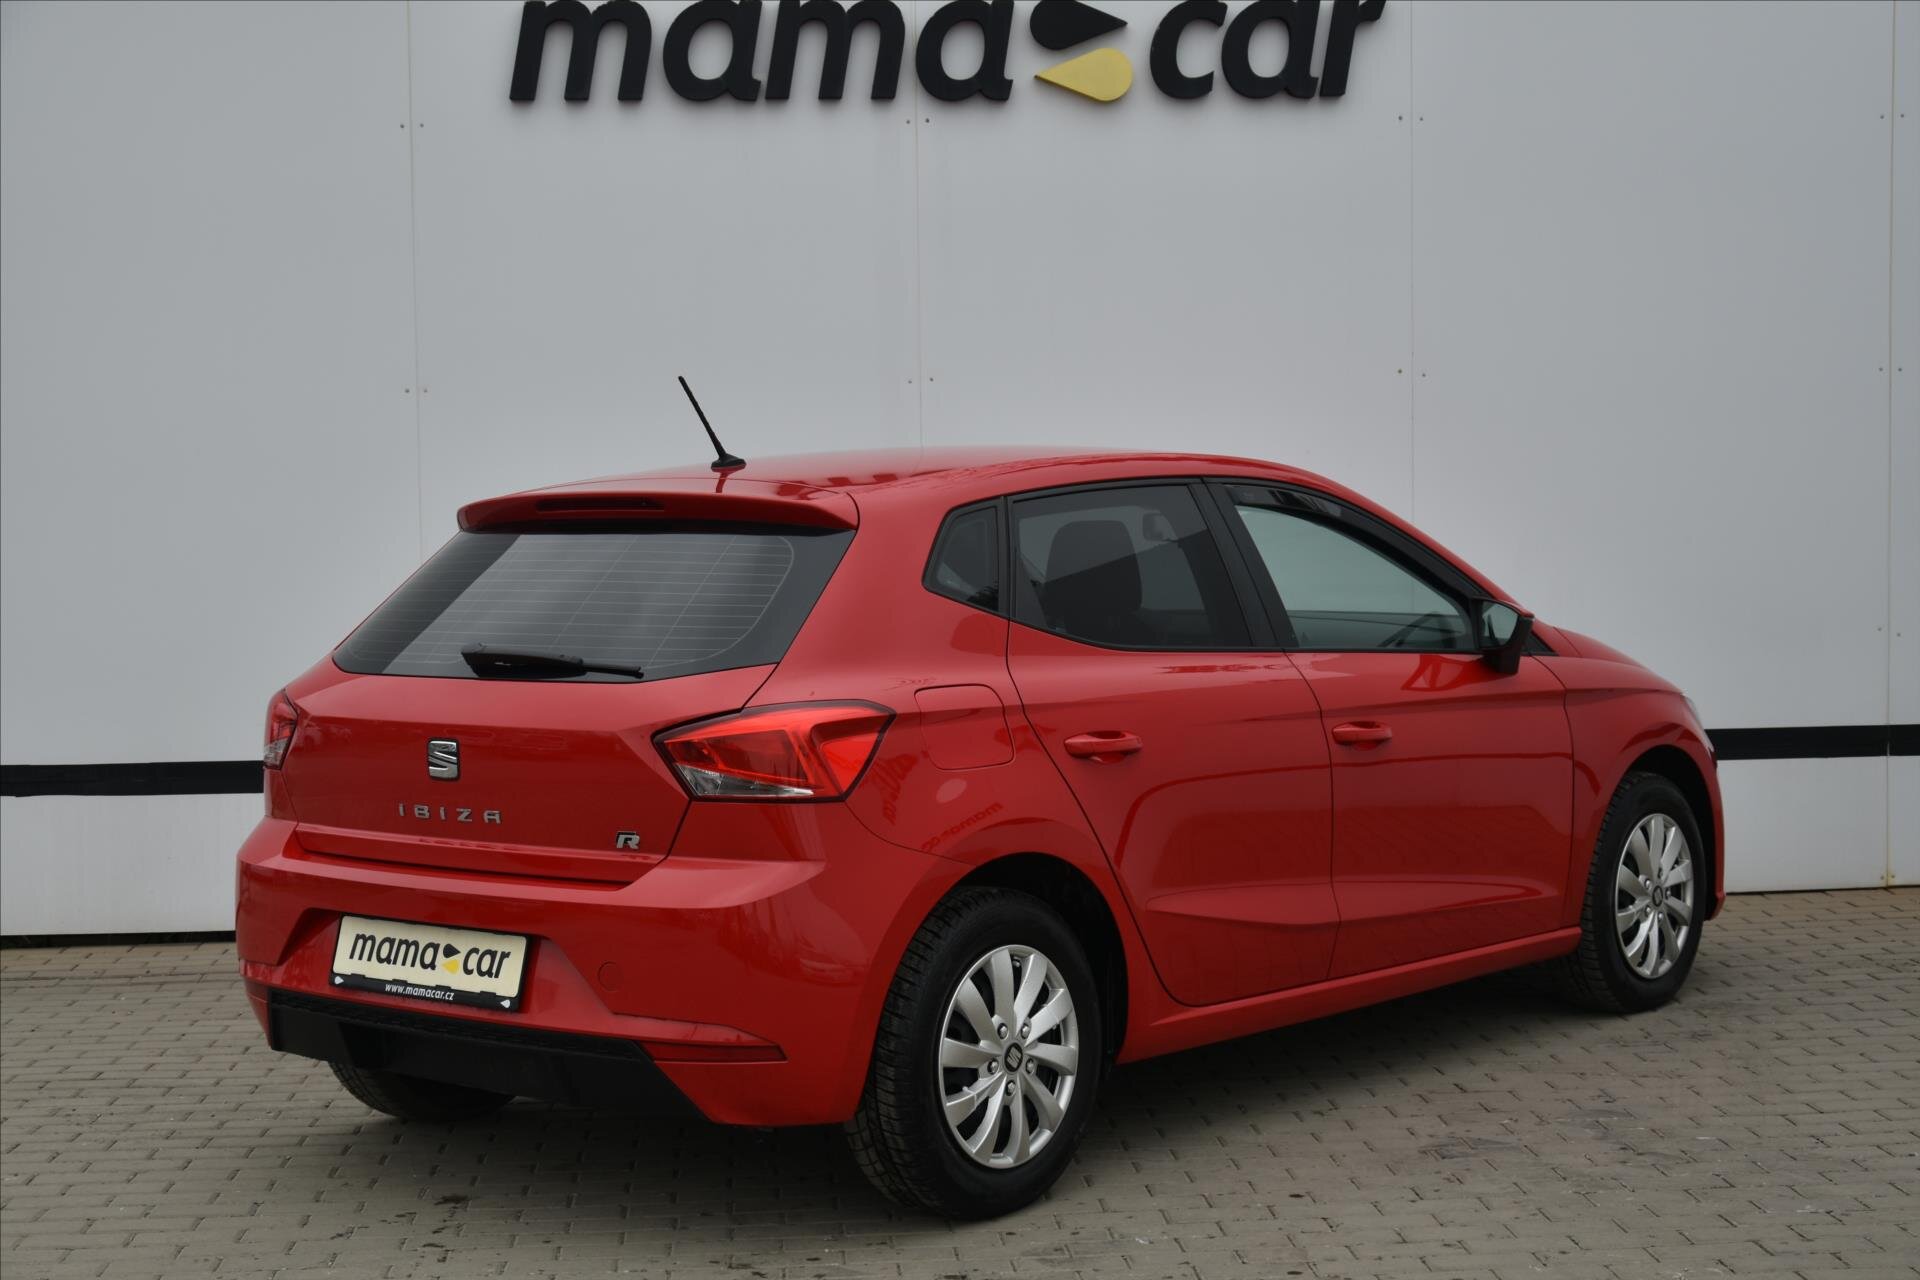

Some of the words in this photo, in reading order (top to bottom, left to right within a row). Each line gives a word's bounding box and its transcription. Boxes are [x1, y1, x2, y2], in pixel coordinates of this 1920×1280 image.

[510, 0, 1014, 101] mama
[1150, 0, 1386, 99] car
[398, 803, 502, 824] IBIZA
[349, 932, 441, 971] mama
[462, 947, 512, 979] car
[384, 983, 455, 1001] www.mamacar.cz
